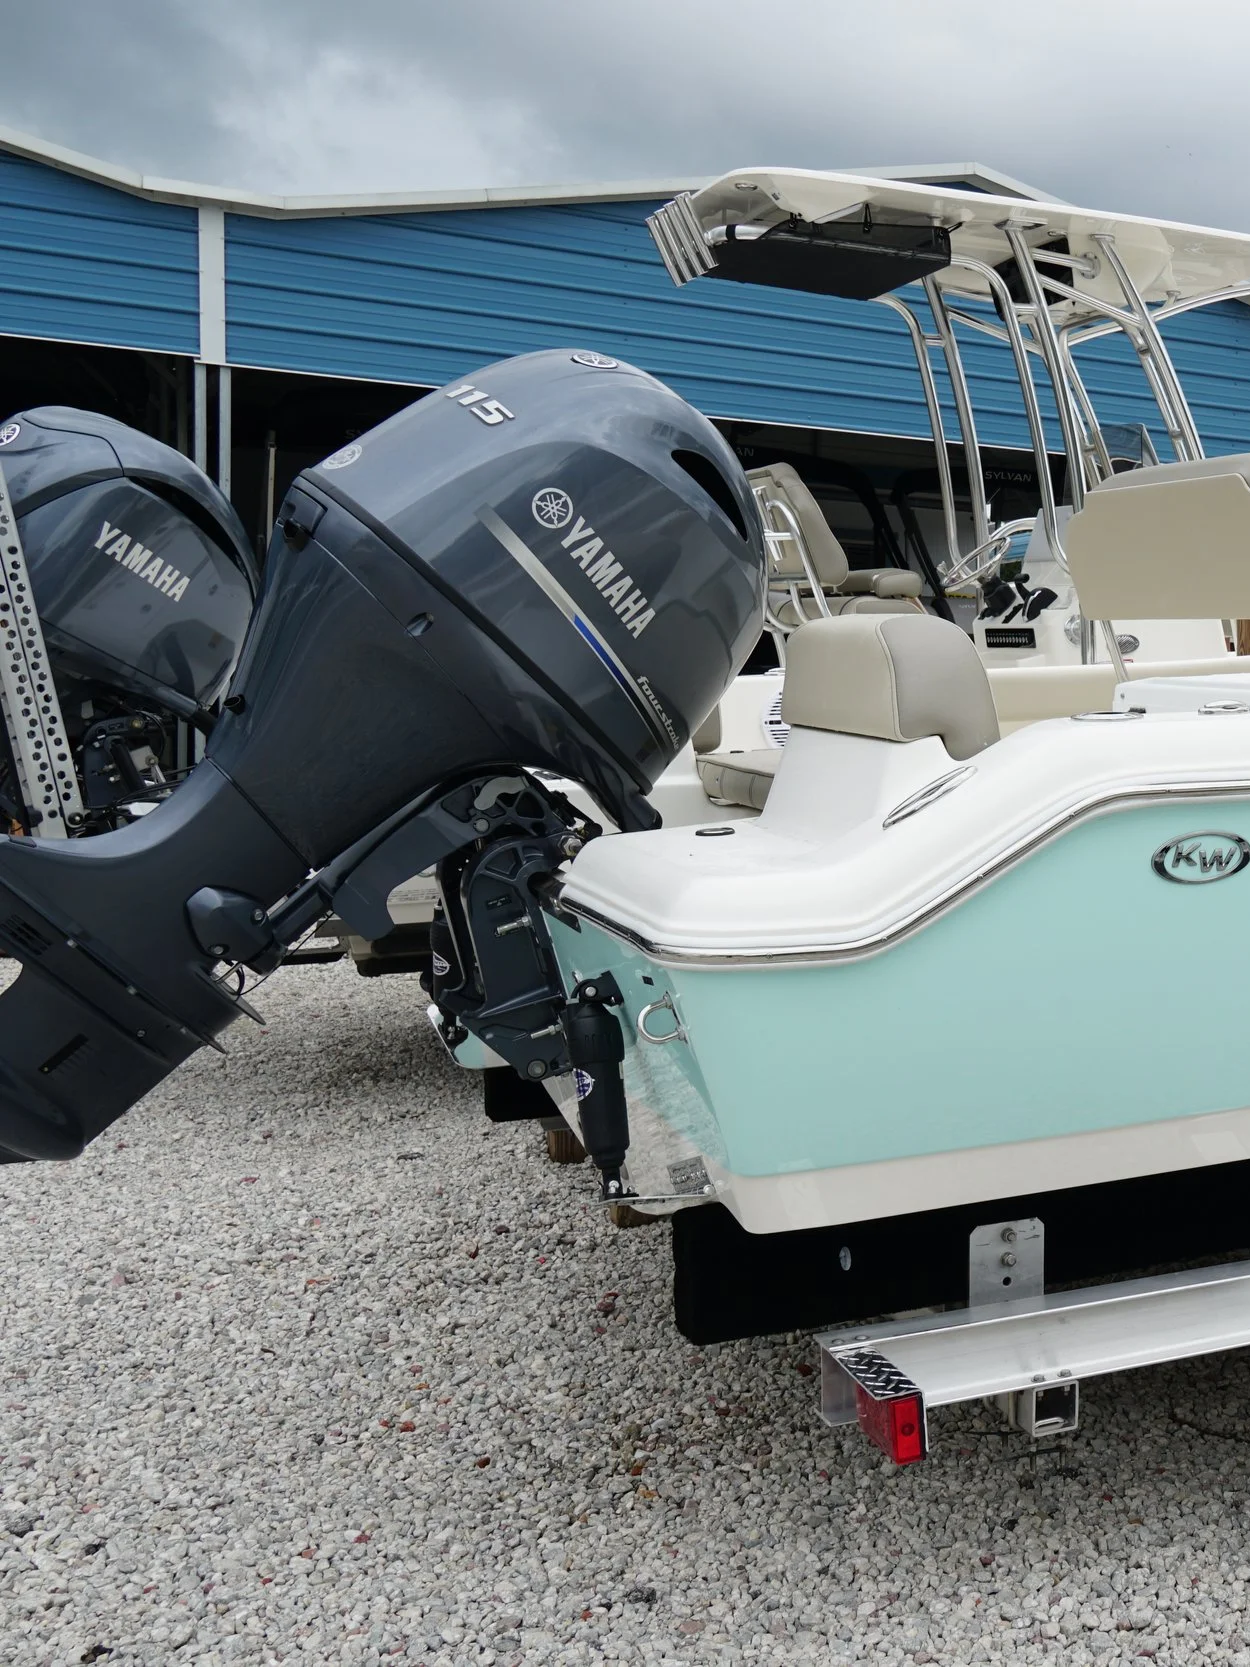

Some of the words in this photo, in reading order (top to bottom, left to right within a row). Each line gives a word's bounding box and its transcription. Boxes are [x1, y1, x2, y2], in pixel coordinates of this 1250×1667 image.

[445, 385, 515, 424] 115
[984, 471, 1032, 482] SYLVAN
[94, 520, 191, 602] YAMAHA
[561, 515, 656, 639] YAMAHA
[1171, 842, 1238, 873] KW
